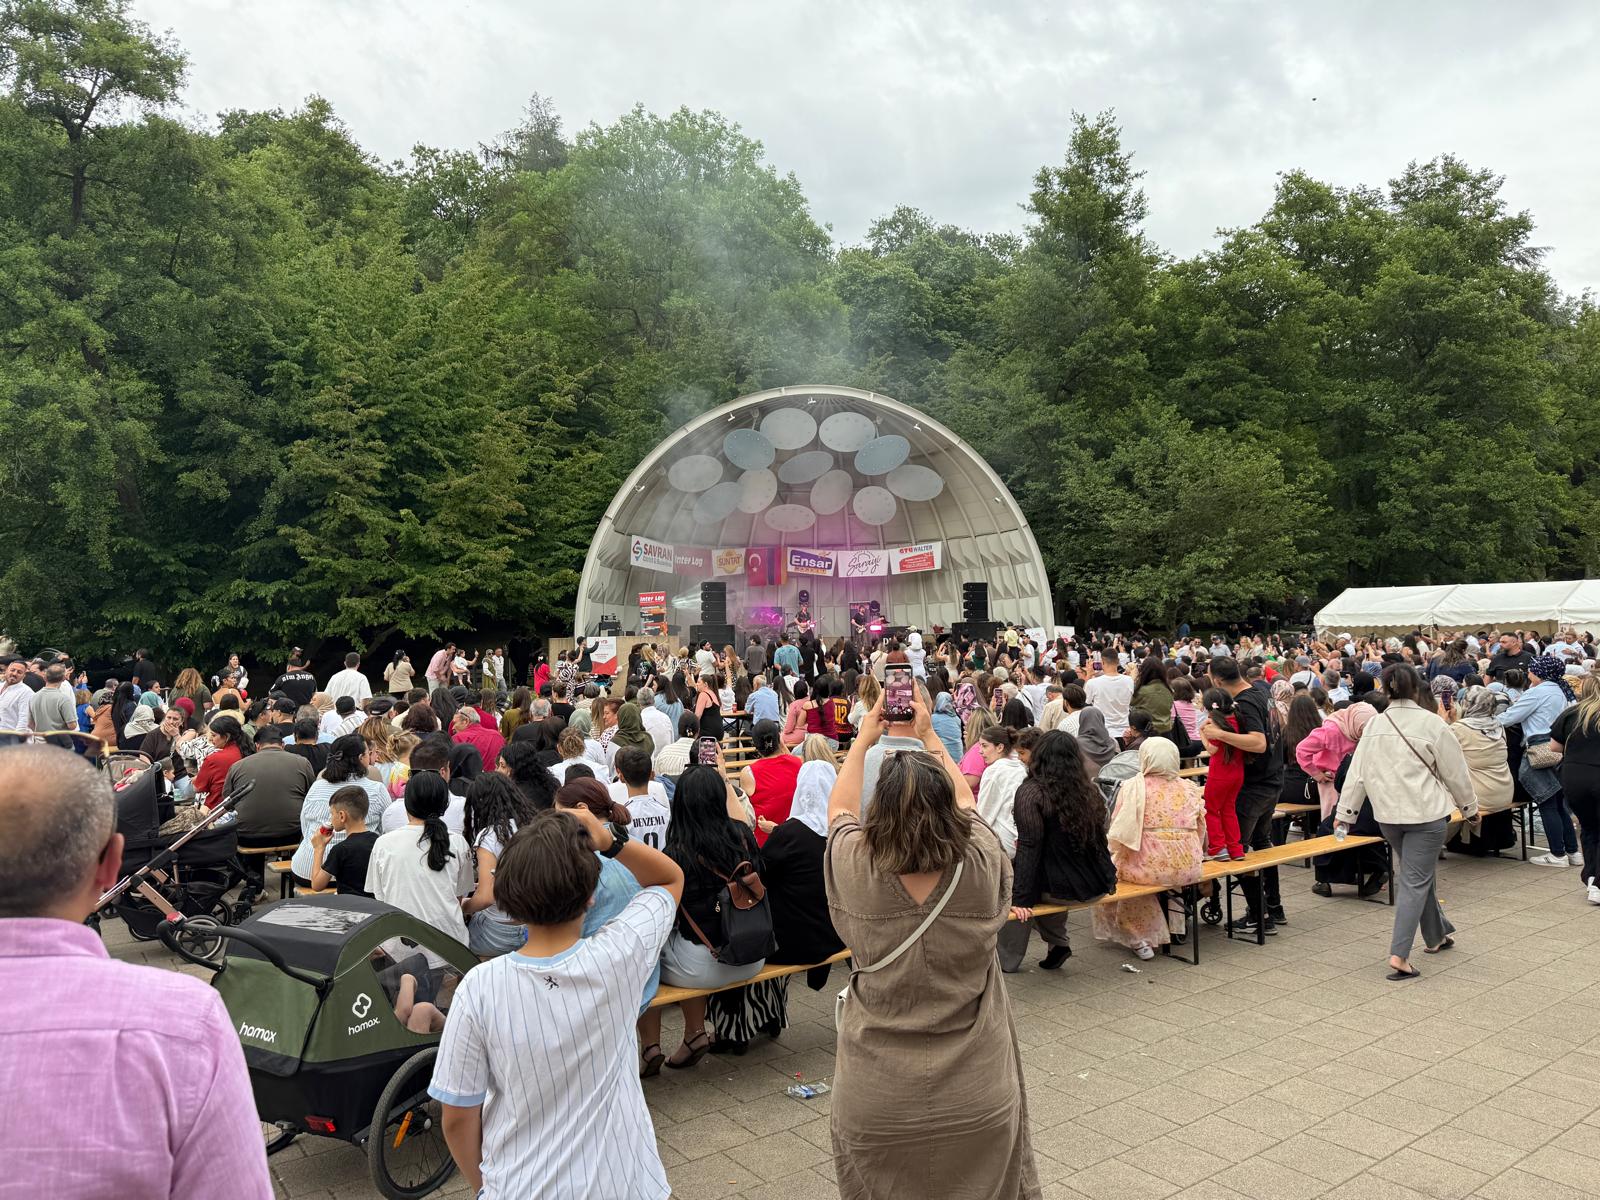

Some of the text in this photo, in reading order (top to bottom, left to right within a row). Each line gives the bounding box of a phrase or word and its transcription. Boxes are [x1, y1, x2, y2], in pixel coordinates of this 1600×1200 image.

[643, 543, 672, 561] SAVRAN
[913, 544, 933, 553] WALTER
[691, 556, 704, 568] Log
[718, 555, 741, 567] SUNTAT
[791, 554, 832, 569] Ensar
[632, 815, 666, 828] BENZEMA
[238, 1022, 277, 1043] hamax
[348, 1017, 379, 1036] hamax
